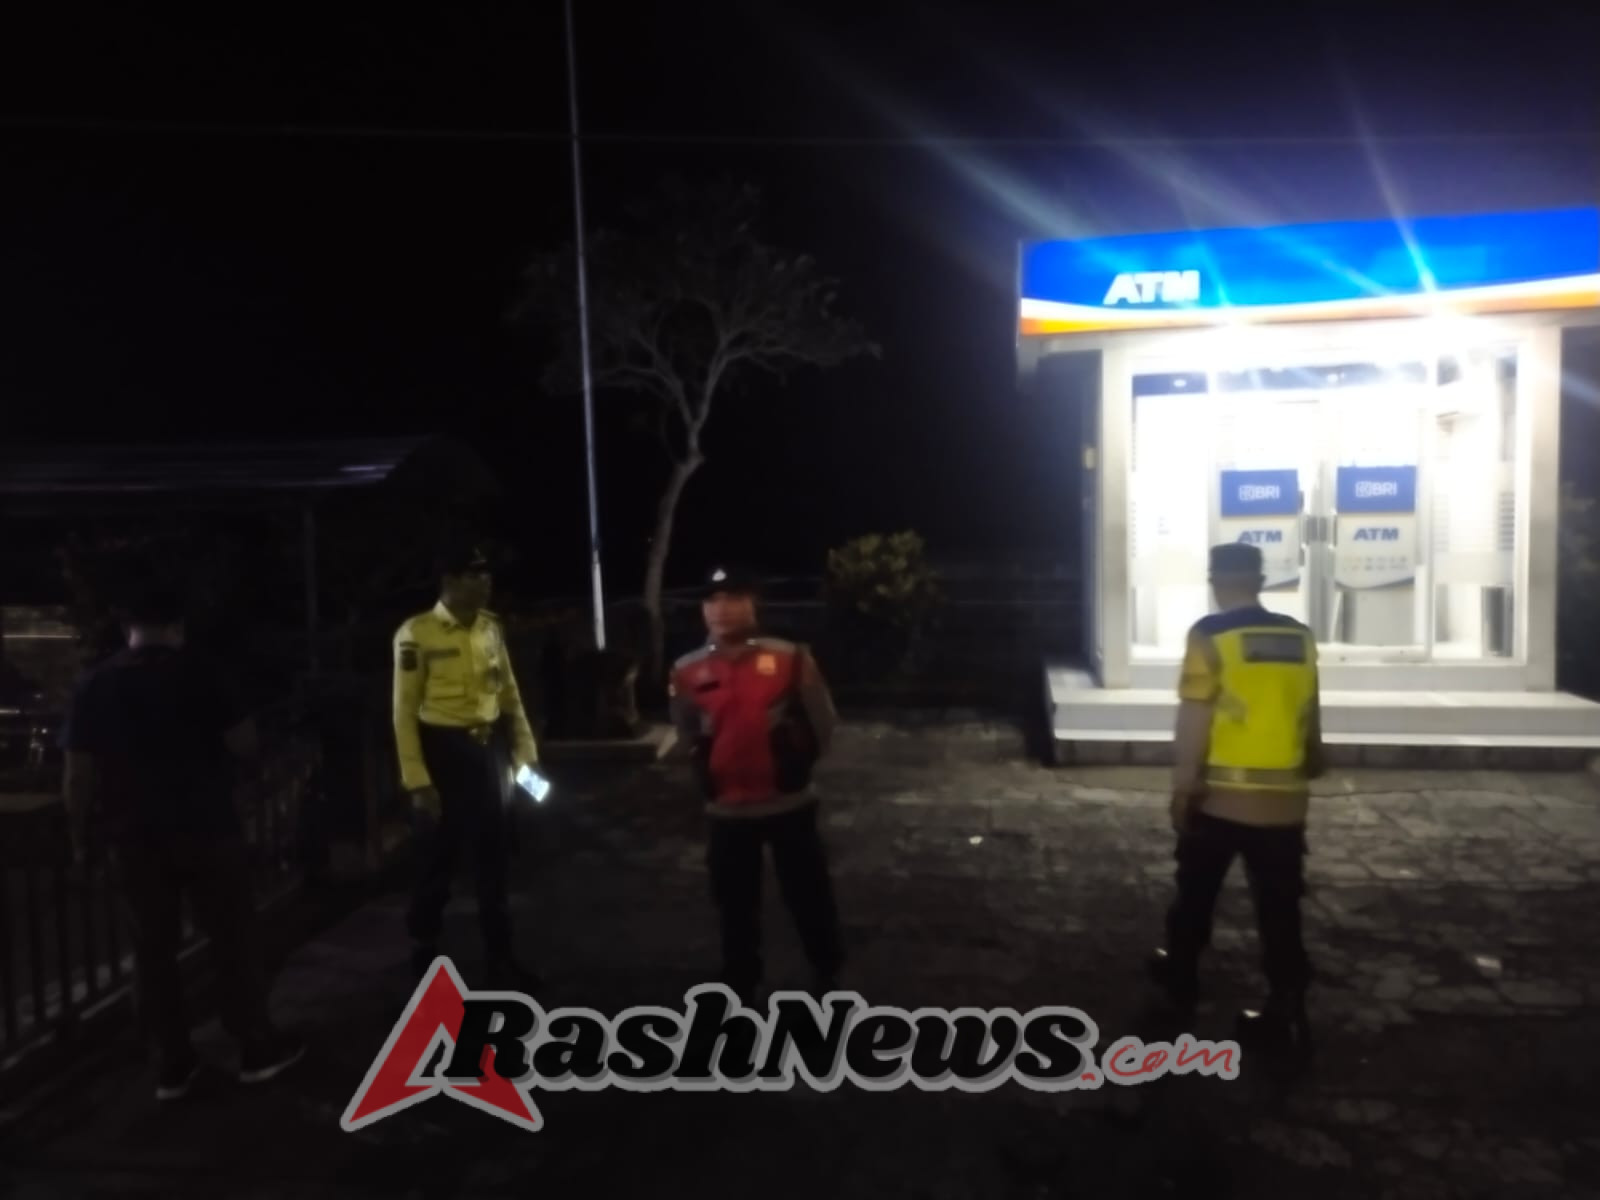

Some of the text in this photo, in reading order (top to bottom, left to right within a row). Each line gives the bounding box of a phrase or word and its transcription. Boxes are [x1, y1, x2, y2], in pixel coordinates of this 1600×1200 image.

[1103, 271, 1200, 305] ATM
[1253, 485, 1281, 499] BRI
[1371, 482, 1398, 496] BRI
[1237, 530, 1283, 543] ATM
[1354, 527, 1400, 541] ATM
